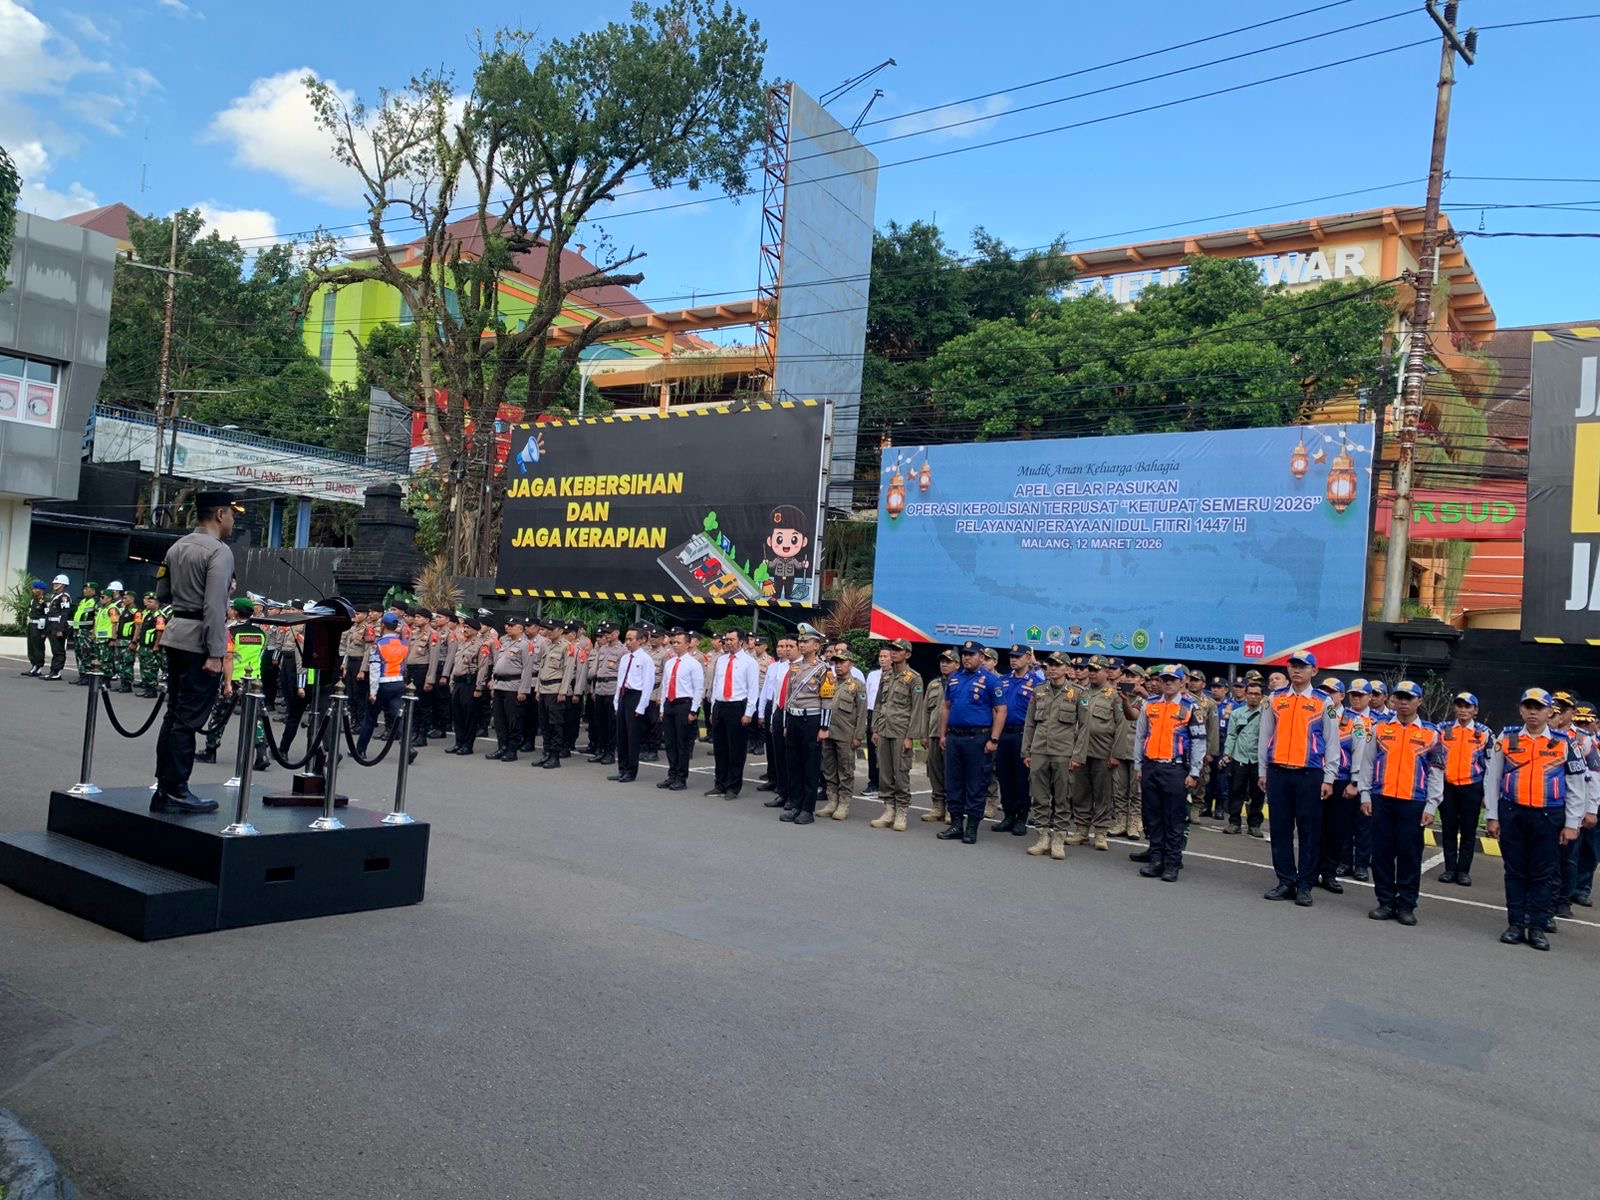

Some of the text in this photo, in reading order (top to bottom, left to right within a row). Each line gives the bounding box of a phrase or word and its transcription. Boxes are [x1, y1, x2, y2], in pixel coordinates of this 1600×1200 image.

[1256, 246, 1367, 287] WAR
[1575, 356, 1600, 418] J
[1017, 459, 1180, 477] Mudik Aman Keluarga Bahagia
[236, 466, 282, 482] MALANG
[290, 476, 315, 488] KOTA
[325, 481, 357, 495] BUNGA
[507, 472, 684, 498] JAGA KEBERSIHAN
[1015, 479, 1179, 497] APEL GELAR PASUKAN
[566, 502, 610, 522] DAN
[906, 502, 960, 516] OPERASI
[962, 501, 1040, 516] KEPOLISIAN
[1043, 500, 1118, 515] TERPUSAT
[1201, 497, 1271, 513] SEMERU
[1412, 500, 1518, 524] RSUD
[955, 517, 1247, 533] PELAYANAN PERAYAAN IDUL FITRI 1447 H
[511, 528, 666, 548] JAGA KERAPIAN
[1021, 538, 1163, 549] MALANG, 12 MARET 2026
[1565, 543, 1600, 611] J
[934, 624, 1000, 638] PRESISI
[1246, 645, 1263, 654] 110
